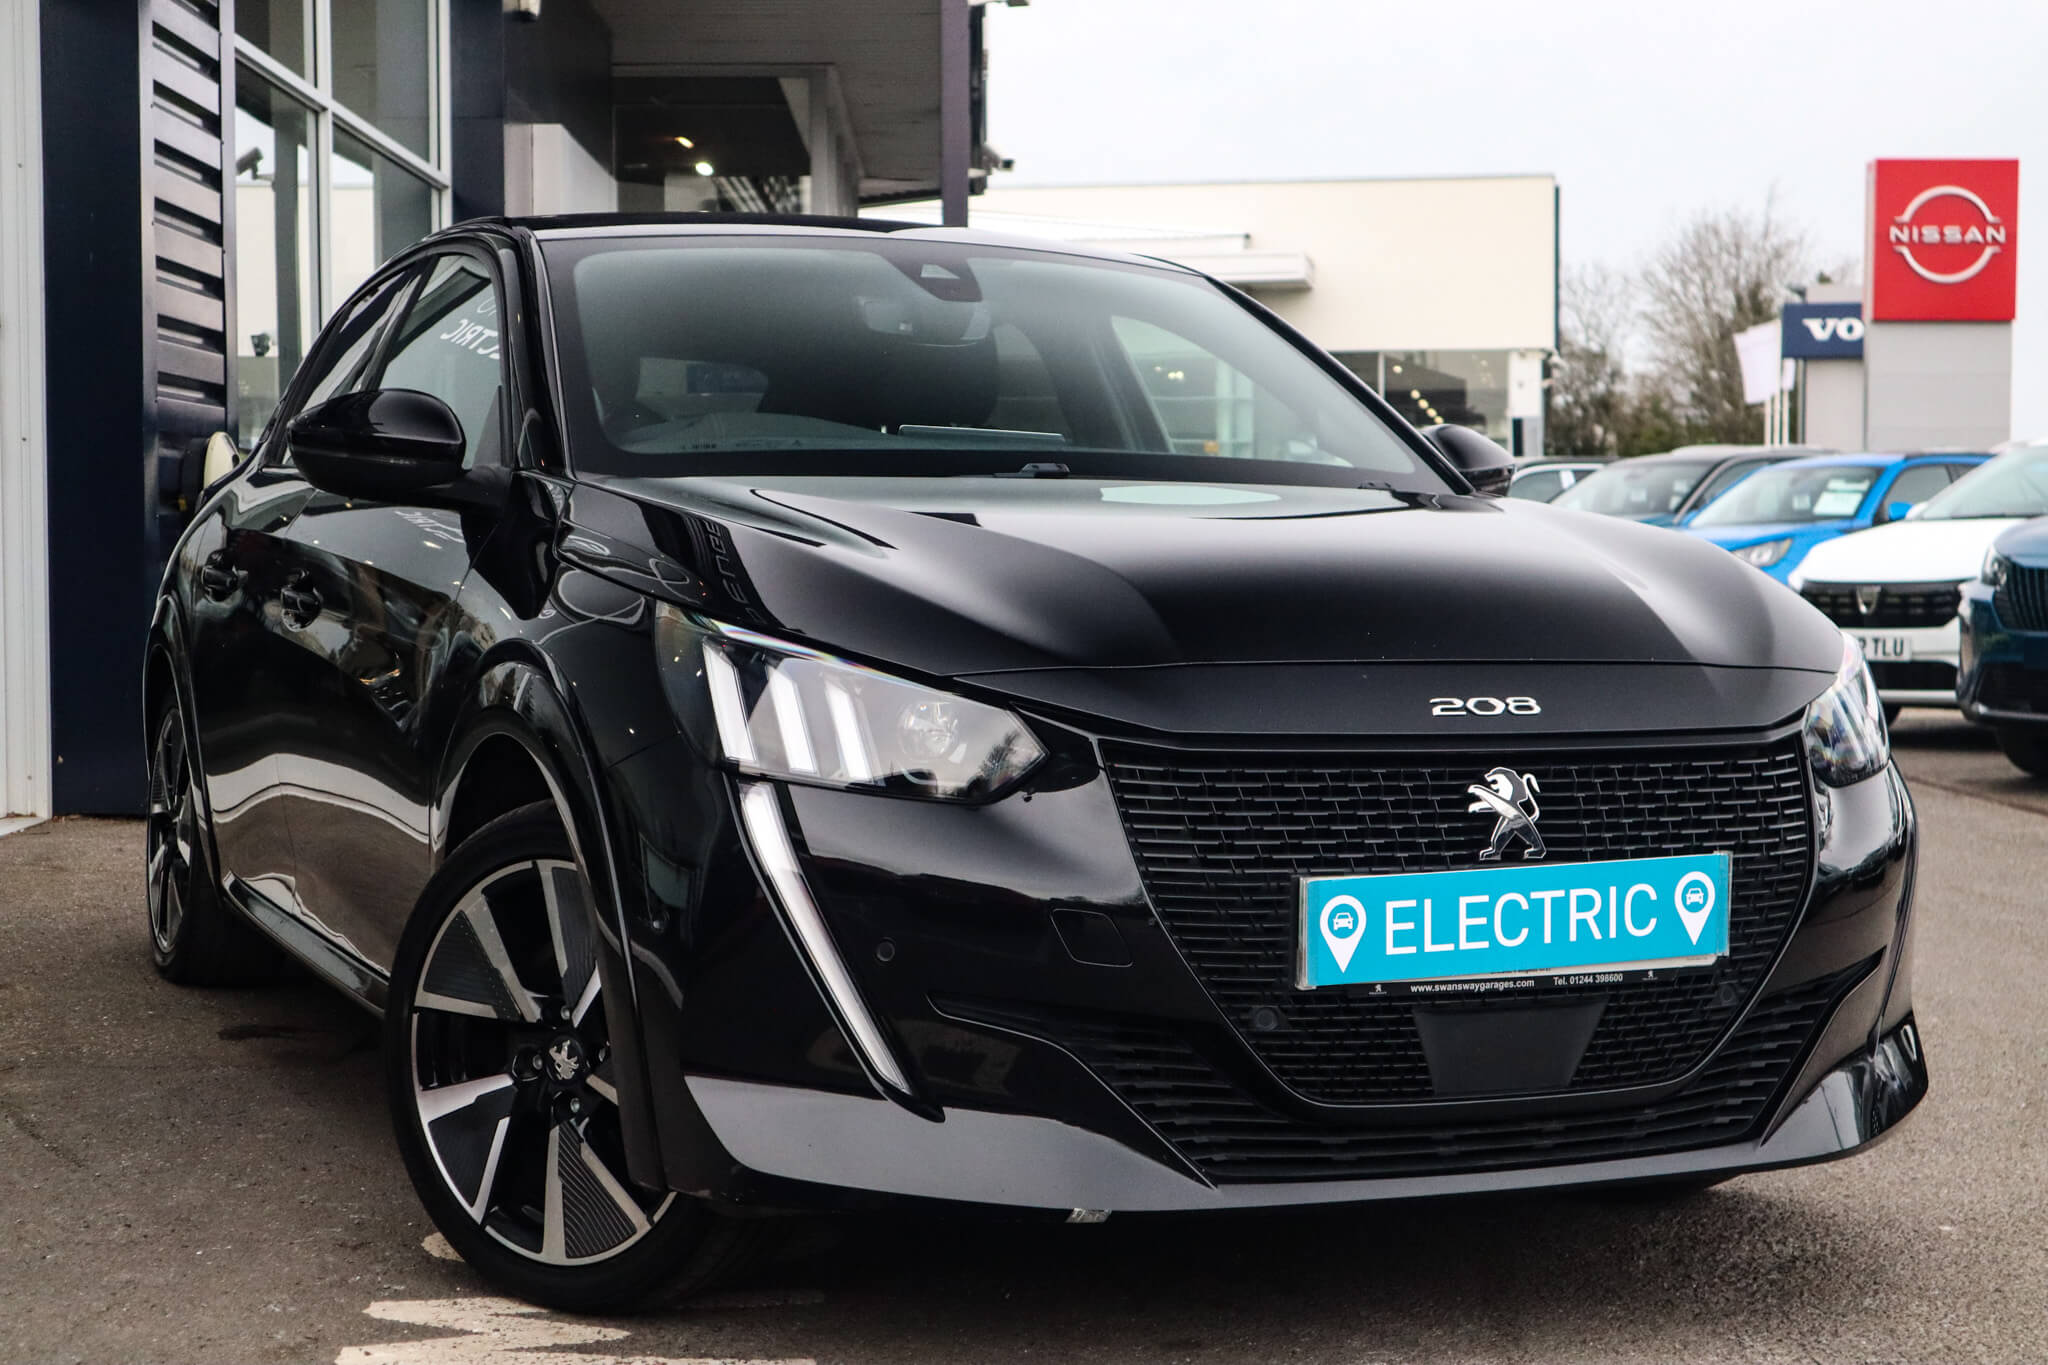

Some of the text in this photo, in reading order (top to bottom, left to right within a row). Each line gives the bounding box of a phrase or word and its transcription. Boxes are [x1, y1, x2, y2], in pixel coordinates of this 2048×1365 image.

[1889, 225, 2006, 244] NISSAN
[1872, 637, 1904, 657] TLU
[1429, 696, 1542, 716] 208
[1385, 882, 1658, 956] ELECTRIC
[1410, 979, 1535, 993] www.swanswaygarages.com
[1553, 976, 1567, 986] Tel.
[1569, 974, 1594, 985] 01244
